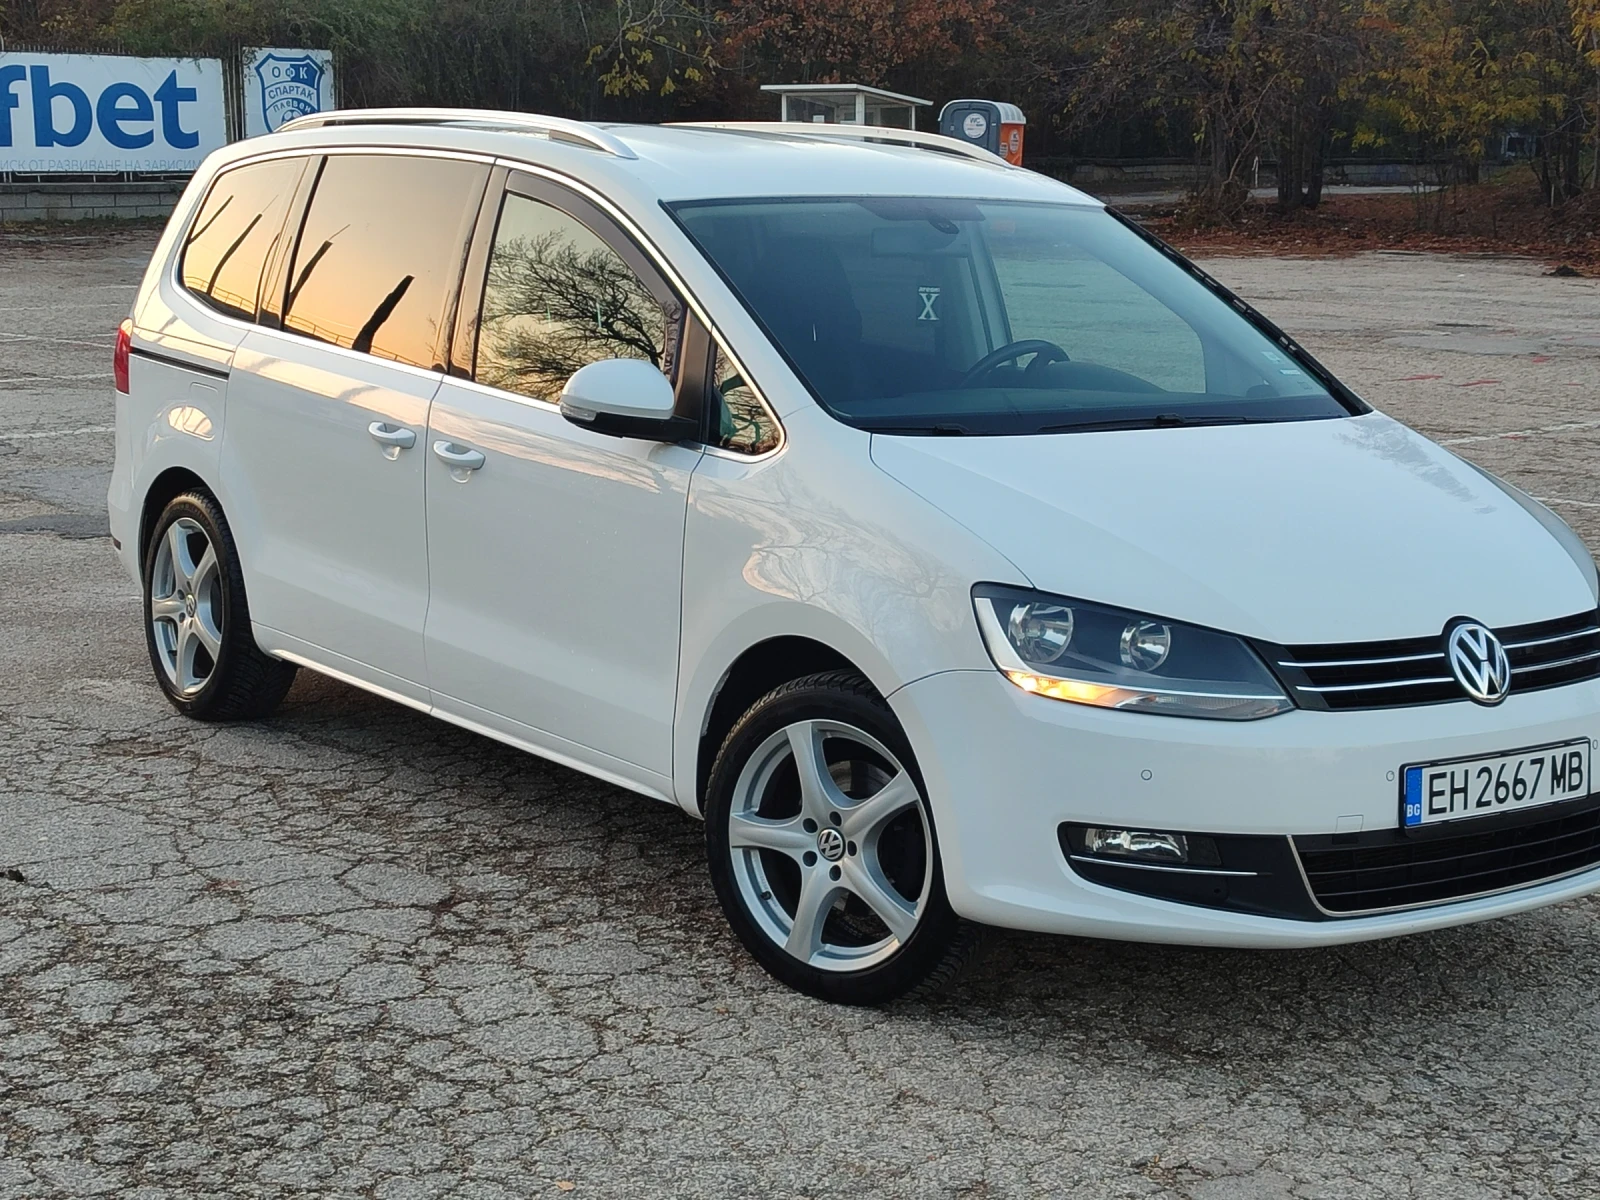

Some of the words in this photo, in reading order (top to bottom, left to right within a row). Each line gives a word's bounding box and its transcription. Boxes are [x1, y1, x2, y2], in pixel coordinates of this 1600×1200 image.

[272, 66, 308, 79] ОФК
[268, 85, 314, 101] СПАРТАК
[28, 159, 45, 171] ОТ
[48, 159, 120, 171] РАЗВИВАНЕ
[124, 159, 140, 171] НА
[1406, 803, 1421, 817] BG
